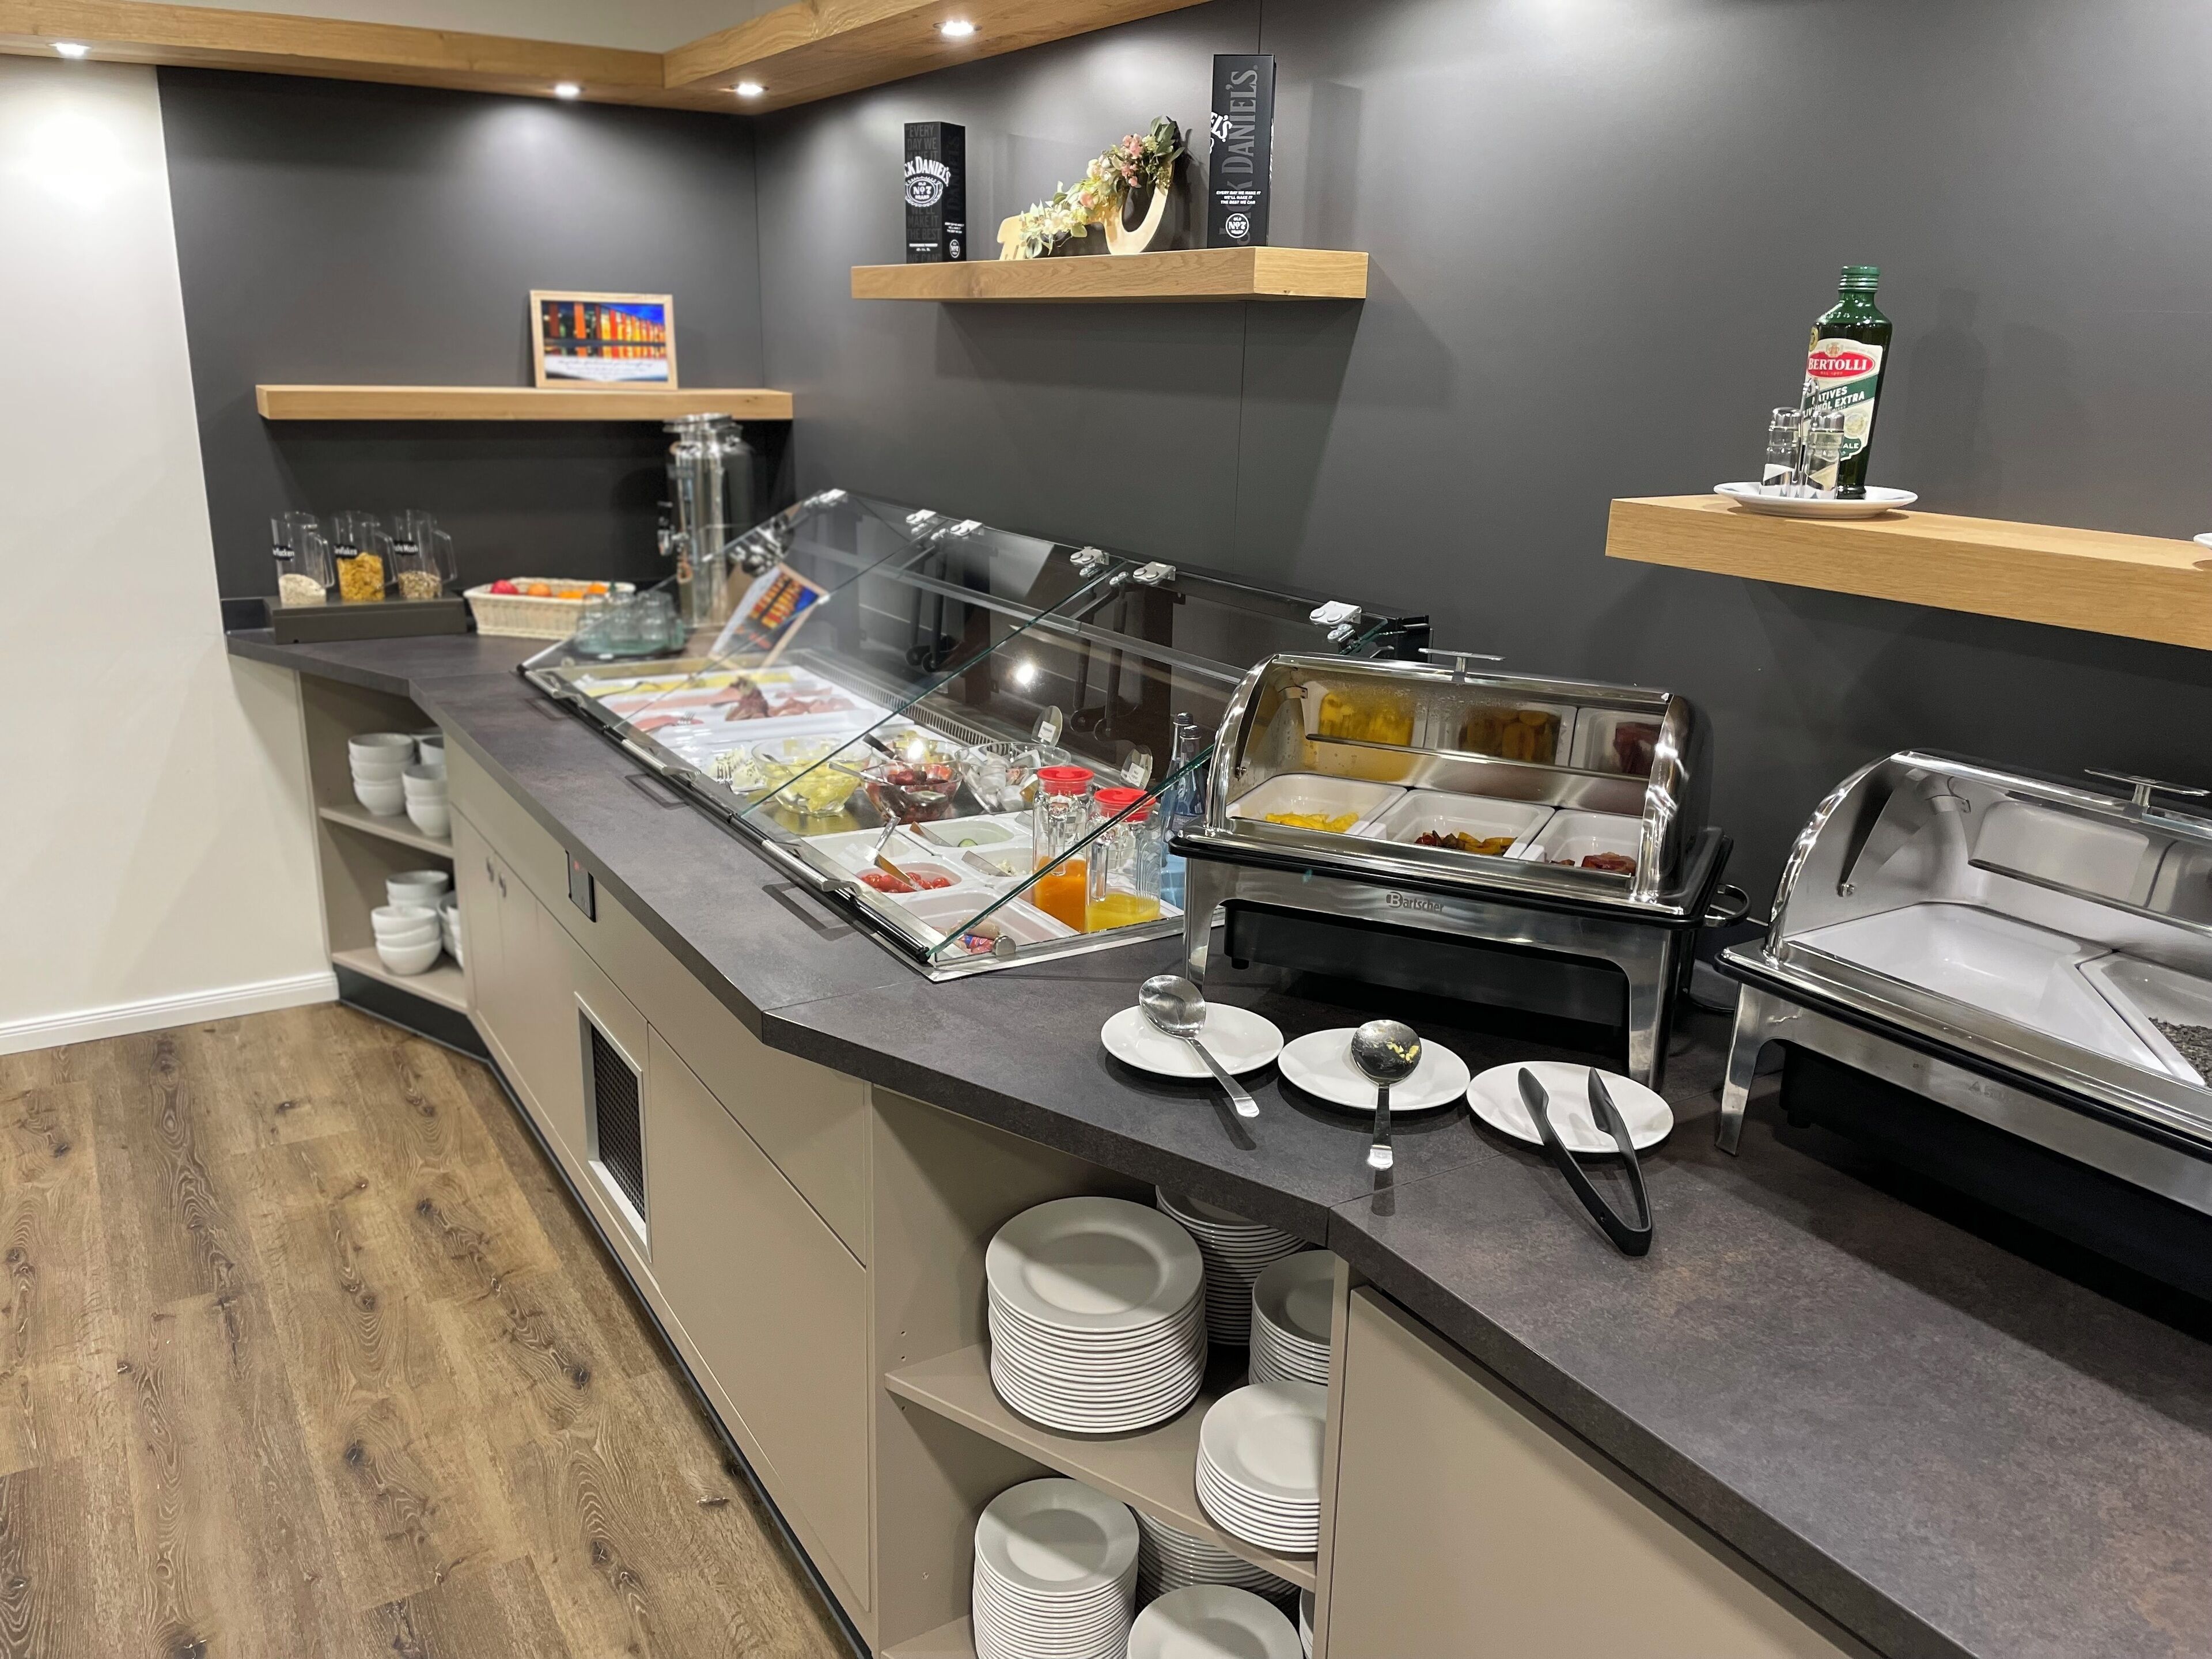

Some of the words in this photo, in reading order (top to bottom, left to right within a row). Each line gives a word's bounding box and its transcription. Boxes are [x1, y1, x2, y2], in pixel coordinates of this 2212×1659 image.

[907, 138, 922, 150] DAY
[924, 138, 937, 150] WE
[908, 215, 929, 227] MAKE
[931, 215, 938, 226] IT
[907, 228, 920, 240] THE
[922, 228, 941, 240] BEST
[1808, 358, 1868, 371] BERTOLLI
[1835, 391, 1865, 408] EXTRA
[1386, 891, 1444, 912] Bartscher
